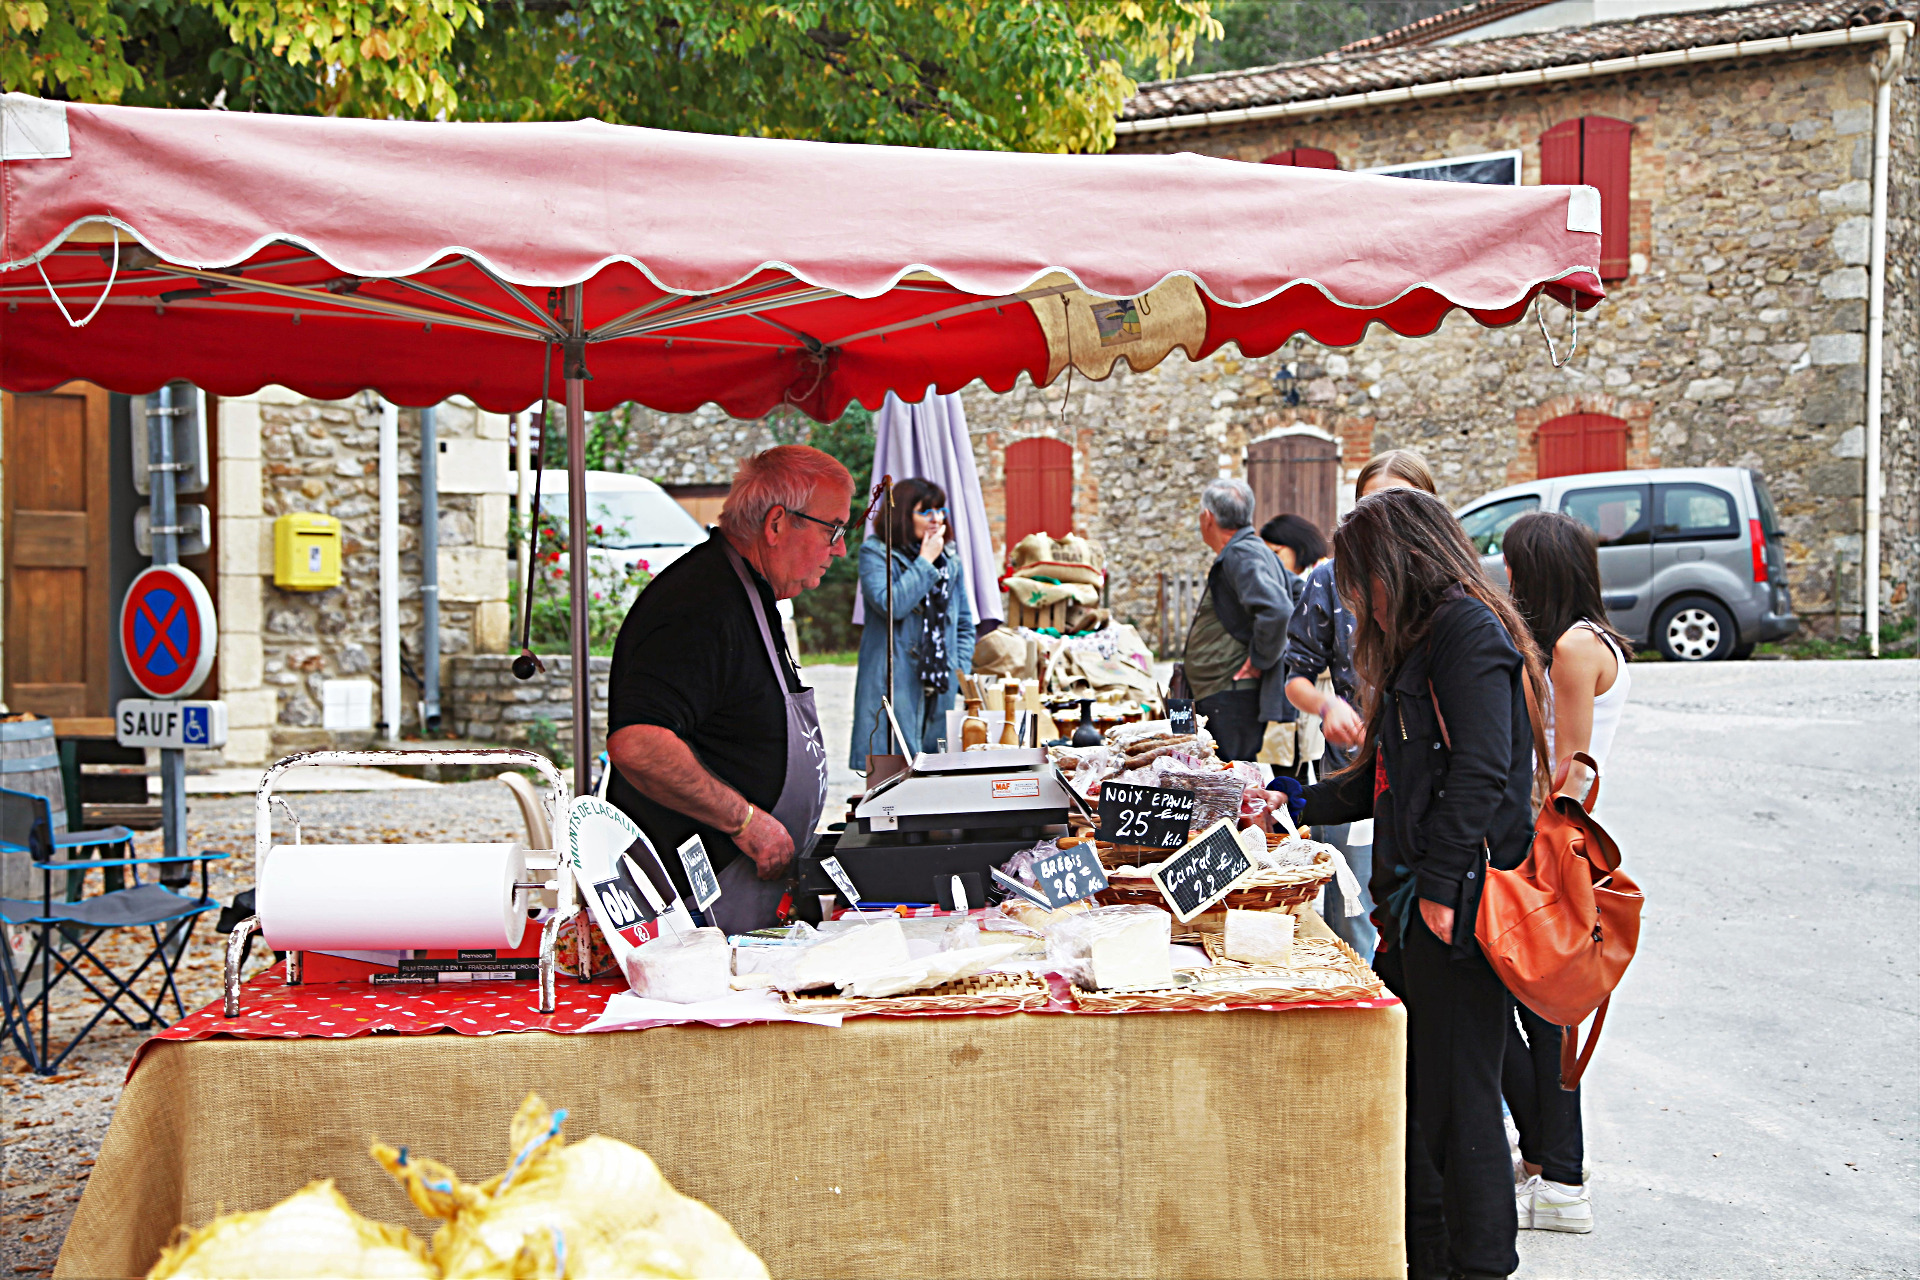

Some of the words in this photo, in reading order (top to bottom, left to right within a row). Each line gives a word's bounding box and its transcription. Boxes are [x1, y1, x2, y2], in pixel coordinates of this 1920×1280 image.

[122, 711, 177, 737] SAUF
[995, 782, 1010, 791] MAF
[577, 802, 592, 817] DE
[591, 802, 646, 842] LACAUN
[1115, 809, 1152, 837] 25
[1161, 830, 1183, 847] Kilo
[1231, 857, 1248, 879] Kilo
[1053, 872, 1077, 899] 26
[1193, 874, 1217, 904] 22
